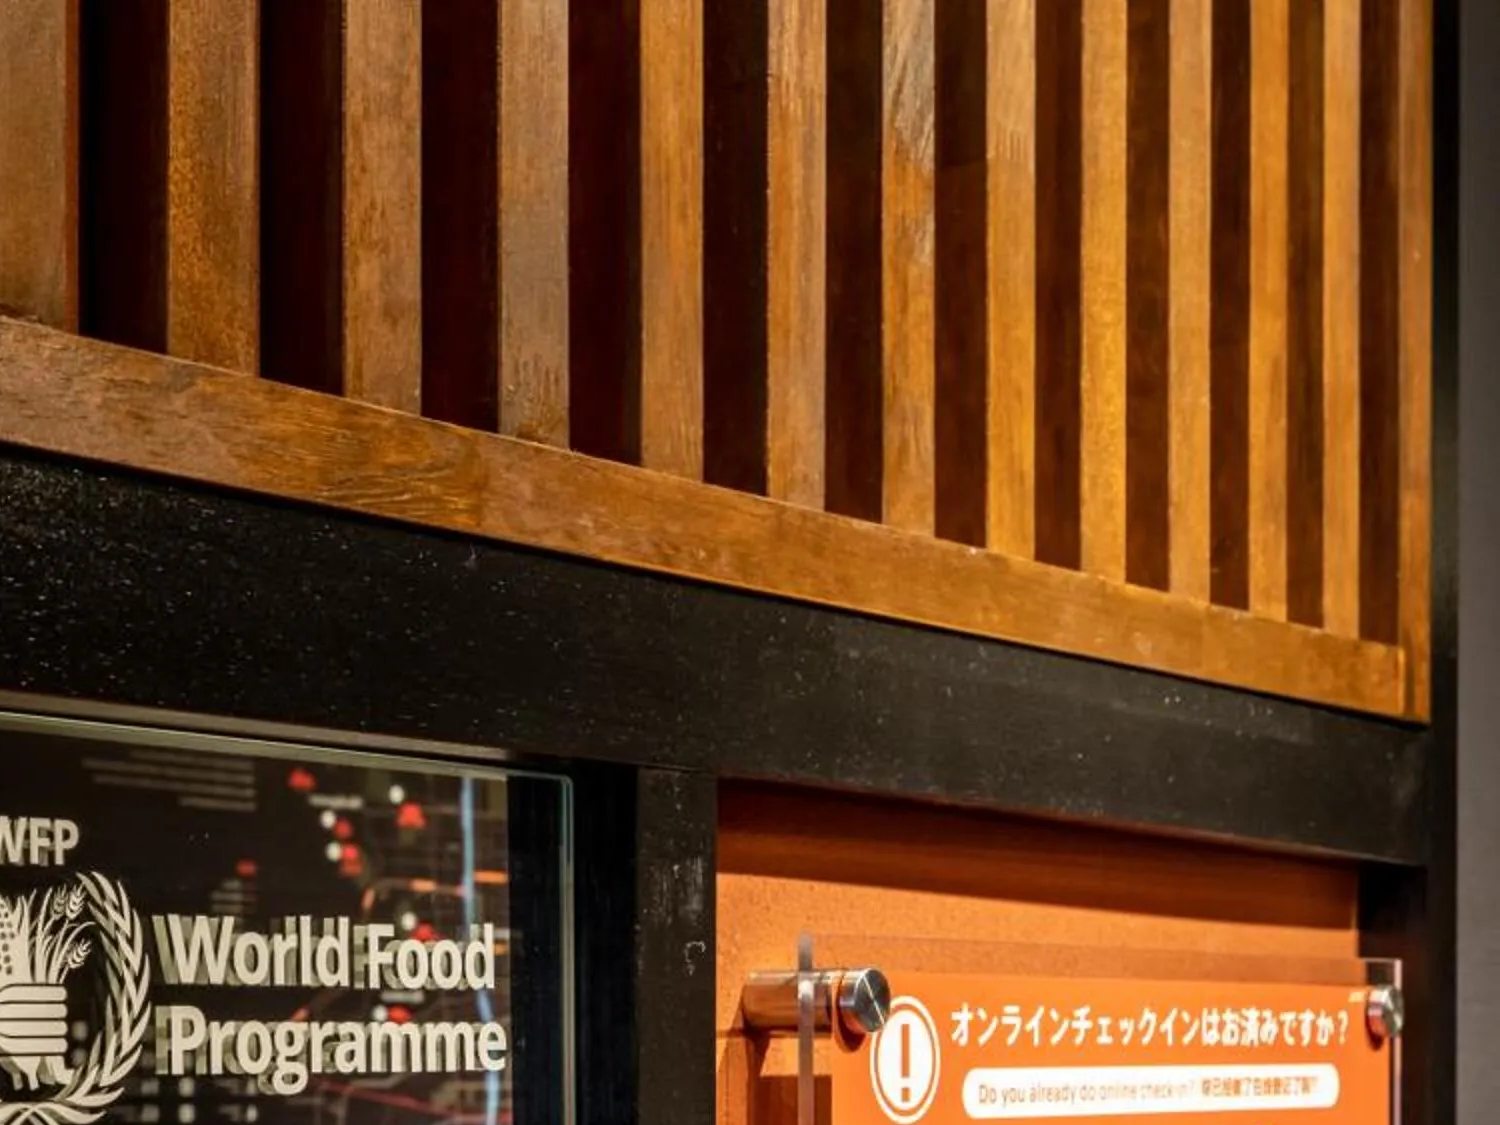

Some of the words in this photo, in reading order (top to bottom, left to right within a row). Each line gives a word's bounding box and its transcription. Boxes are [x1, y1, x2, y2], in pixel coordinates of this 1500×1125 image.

[165, 914, 350, 987] World
[368, 923, 495, 990] Food
[168, 1004, 507, 1094] Programme
[978, 1085, 997, 1104] Do
[1001, 1086, 1026, 1108] you
[1029, 1081, 1077, 1107] already
[1079, 1083, 1096, 1102] do
